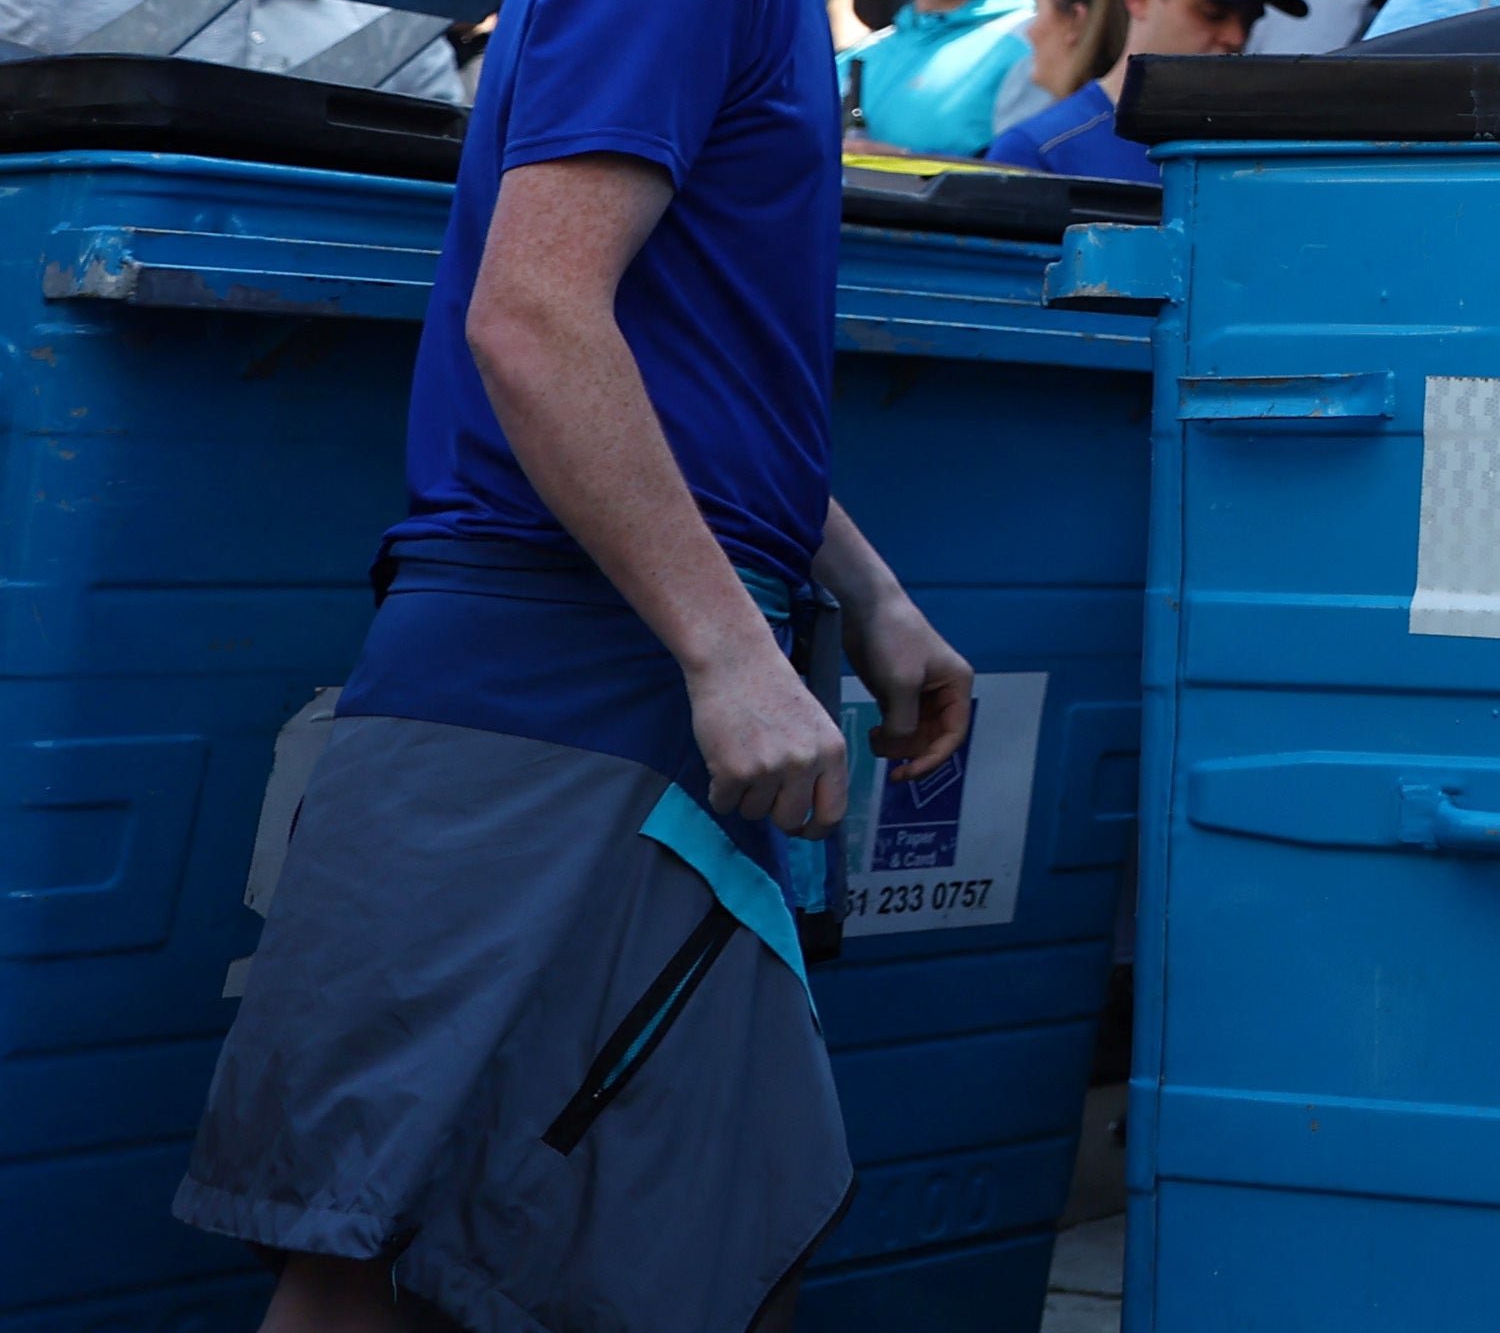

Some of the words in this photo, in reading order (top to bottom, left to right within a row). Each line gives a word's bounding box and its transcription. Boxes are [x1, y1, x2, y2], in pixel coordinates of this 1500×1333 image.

[896, 830, 937, 848] Paper
[904, 850, 938, 868] Card
[845, 888, 868, 917] 51
[877, 885, 924, 914] 233
[932, 879, 992, 910] 0757
